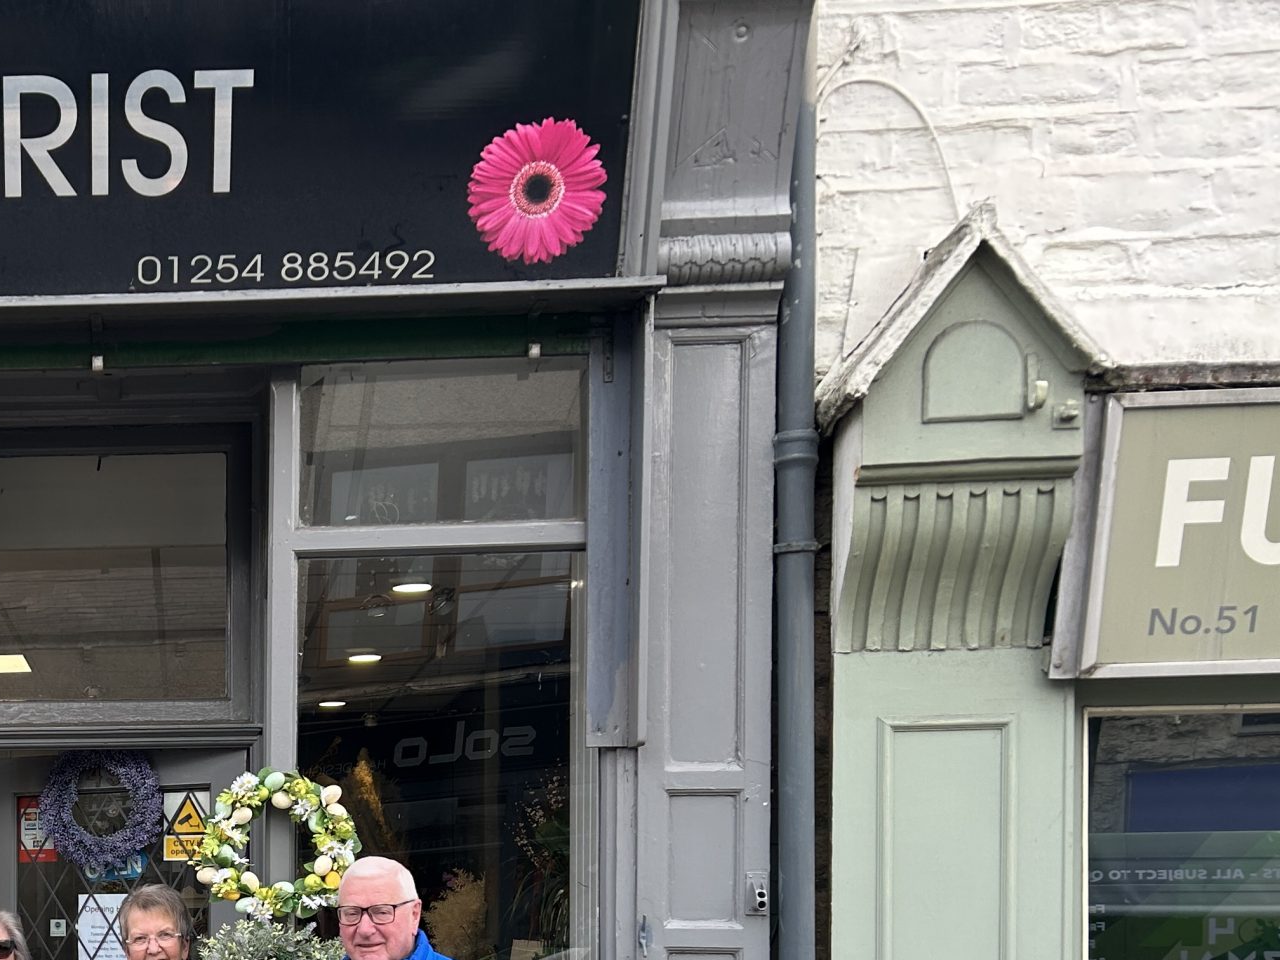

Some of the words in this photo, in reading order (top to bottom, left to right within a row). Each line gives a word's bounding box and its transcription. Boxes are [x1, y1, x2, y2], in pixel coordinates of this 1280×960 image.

[137, 254, 265, 286] 01254
[280, 249, 436, 281] 885492
[1147, 605, 1258, 637] No.51
